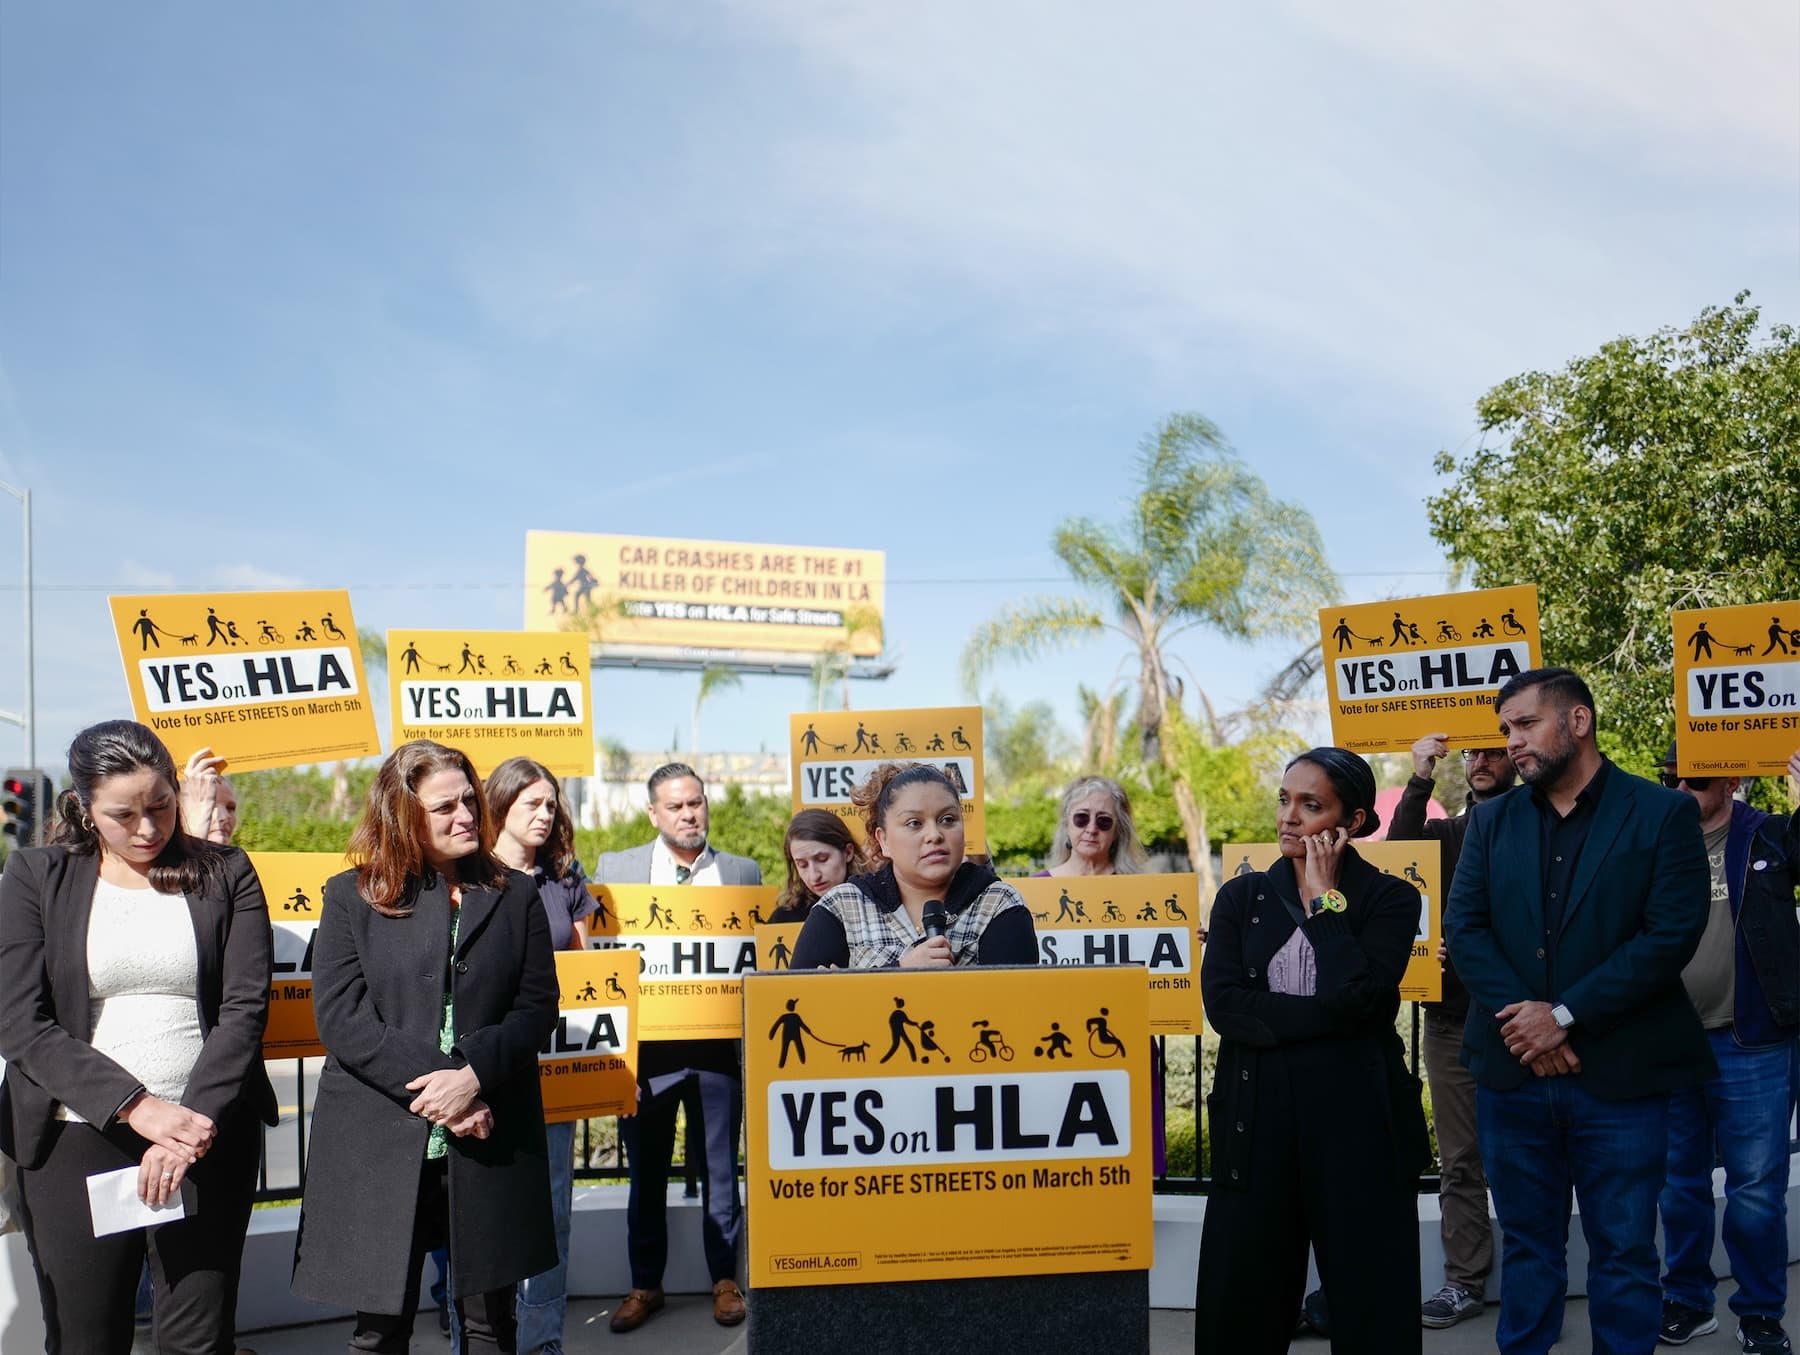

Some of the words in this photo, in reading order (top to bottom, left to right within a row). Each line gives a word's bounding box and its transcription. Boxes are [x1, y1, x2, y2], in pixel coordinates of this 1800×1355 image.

[619, 546, 658, 565] CAR
[664, 548, 754, 571] CRASHES
[760, 555, 796, 574] ARE
[803, 556, 837, 576] THE
[843, 559, 862, 577] #1
[619, 571, 686, 592] KILLER
[692, 574, 715, 593] OF
[722, 576, 816, 598] CHILDREN
[824, 582, 841, 600] IN
[848, 583, 870, 601] LA
[655, 602, 688, 618] YES
[688, 605, 706, 619] on
[708, 604, 749, 621] HLA
[750, 607, 769, 622] for
[769, 608, 796, 624] Safe
[797, 609, 840, 625] Streets
[148, 662, 219, 704] YES
[222, 685, 246, 699] on
[243, 654, 351, 697] HLA
[1341, 659, 1396, 695] YES
[1399, 678, 1420, 691] on
[1420, 648, 1520, 689] HLA
[408, 687, 461, 718] YES
[464, 707, 483, 719] on
[486, 687, 576, 718] HLA
[1340, 704, 1362, 715] Vote
[1365, 702, 1379, 713] for
[1381, 700, 1408, 712] SAFE
[1410, 696, 1457, 710] STREETS
[1459, 697, 1473, 707] on
[1476, 694, 1497, 706] Mar
[1696, 671, 1765, 710] YES
[1768, 693, 1797, 707] on
[152, 717, 181, 730] Vote
[184, 714, 201, 727] for
[205, 710, 235, 725] SAFE
[238, 705, 289, 722] STREETS
[291, 706, 305, 717] on
[308, 701, 342, 715] March
[344, 698, 362, 711] 5th
[1688, 720, 1718, 732] Vote
[1721, 719, 1740, 731] for
[1743, 717, 1778, 730] SAFE
[403, 728, 426, 739] Vote
[429, 728, 443, 738] for
[446, 728, 471, 738] SAFE
[473, 727, 517, 738] STREETS
[520, 729, 532, 737] on
[535, 727, 565, 737] March
[567, 727, 583, 737] 5th
[1692, 761, 1747, 770] YESonHLA.com
[806, 766, 854, 798] YES
[840, 806, 859, 816] SAF
[649, 963, 669, 975] on
[673, 942, 757, 974] HLA
[1083, 933, 1184, 968] HLA
[1410, 945, 1428, 956] 5th
[284, 985, 312, 1000] Mar
[638, 984, 655, 996] AFE
[658, 984, 703, 995] STREETS
[705, 986, 718, 995] on
[720, 984, 743, 994] Marc
[1150, 978, 1170, 989] rch
[1173, 978, 1191, 989] 5th
[541, 1013, 620, 1054] LA
[555, 1065, 568, 1075] on
[572, 1060, 605, 1073] March
[609, 1057, 626, 1070] 5th
[781, 1089, 885, 1157] YES
[890, 1130, 930, 1154] on
[935, 1081, 1119, 1152] HLA
[769, 1178, 814, 1199] Vote
[820, 1176, 848, 1197] for
[854, 1174, 904, 1196] SAFE
[910, 1170, 996, 1194] STREETS
[1002, 1173, 1026, 1189] on
[1033, 1166, 1093, 1189] March
[1099, 1164, 1130, 1186] 5th
[774, 1256, 858, 1270] YESonHLA.com
